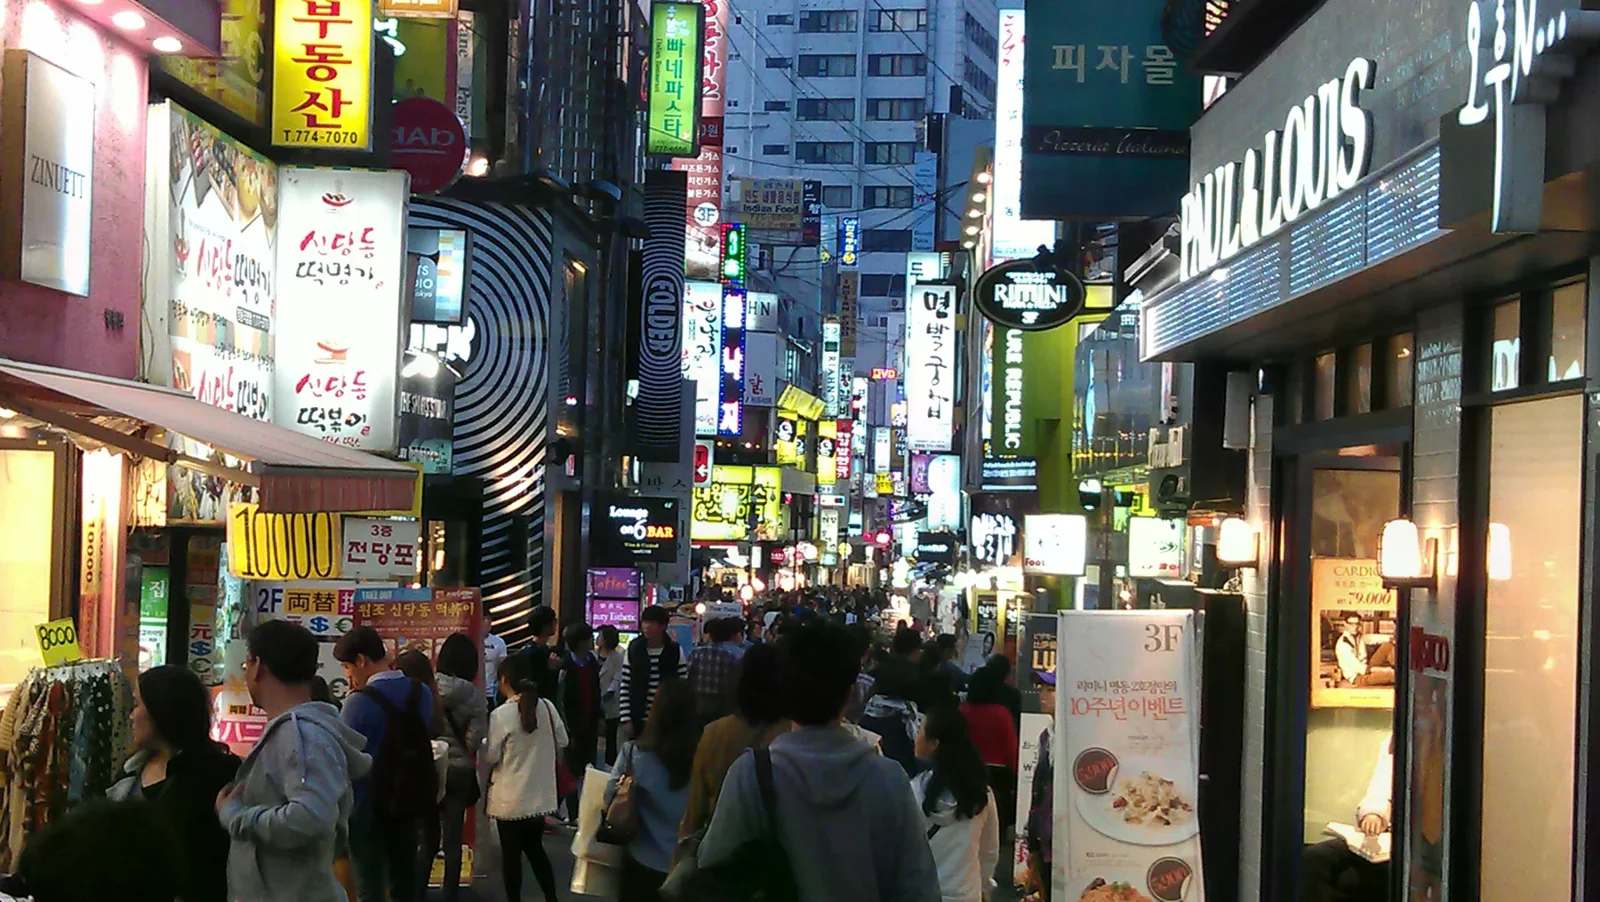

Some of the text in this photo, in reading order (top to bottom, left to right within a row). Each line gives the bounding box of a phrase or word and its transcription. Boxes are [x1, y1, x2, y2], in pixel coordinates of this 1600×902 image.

[290, 0, 353, 130] 부동산
[1051, 43, 1178, 85] 피자몰
[664, 38, 686, 139] 빠네파스타
[456, 86, 473, 126] Past
[282, 129, 359, 144] T.774-7070
[30, 155, 86, 199] ZINUETT
[697, 208, 716, 222] 3F
[743, 204, 799, 213] Indian Food
[299, 227, 375, 259] 신당동
[994, 283, 1067, 303] RIMINI
[295, 370, 367, 400] 신당동
[296, 406, 367, 433] 떡볶이
[1004, 368, 1023, 449] REPUBLIC
[608, 505, 649, 520] Lounge
[236, 505, 333, 579] 10000
[647, 526, 674, 538] BAR
[347, 541, 413, 566] 전당포
[258, 588, 283, 614] 2F
[288, 591, 336, 613] 両替
[358, 602, 386, 618] 원조
[390, 602, 431, 618] 신당동
[39, 626, 75, 651] 8000
[1143, 623, 1184, 652] 3F
[1076, 680, 1108, 692] 리미니
[1109, 680, 1131, 694] 명동
